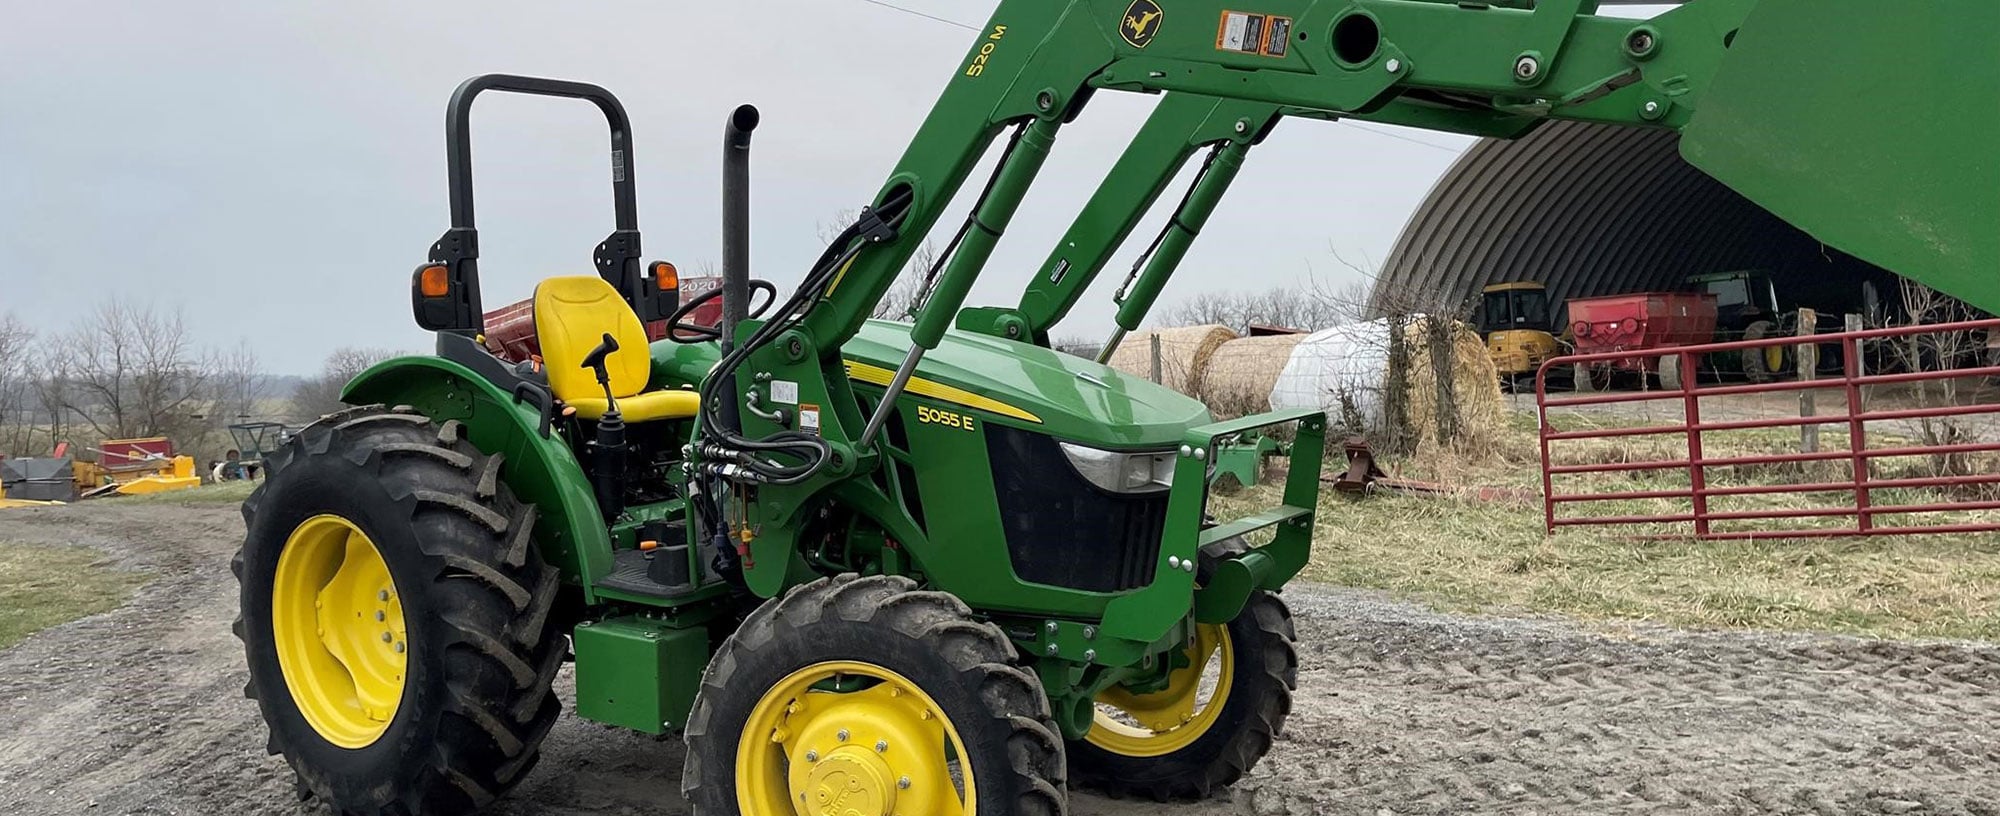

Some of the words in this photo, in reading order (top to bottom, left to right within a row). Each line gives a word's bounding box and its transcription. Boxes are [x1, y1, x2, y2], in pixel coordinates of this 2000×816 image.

[965, 42, 995, 77] 520
[989, 25, 1008, 40] M
[680, 280, 717, 293] 2020
[917, 405, 961, 428] 5055
[962, 415, 975, 431] E
